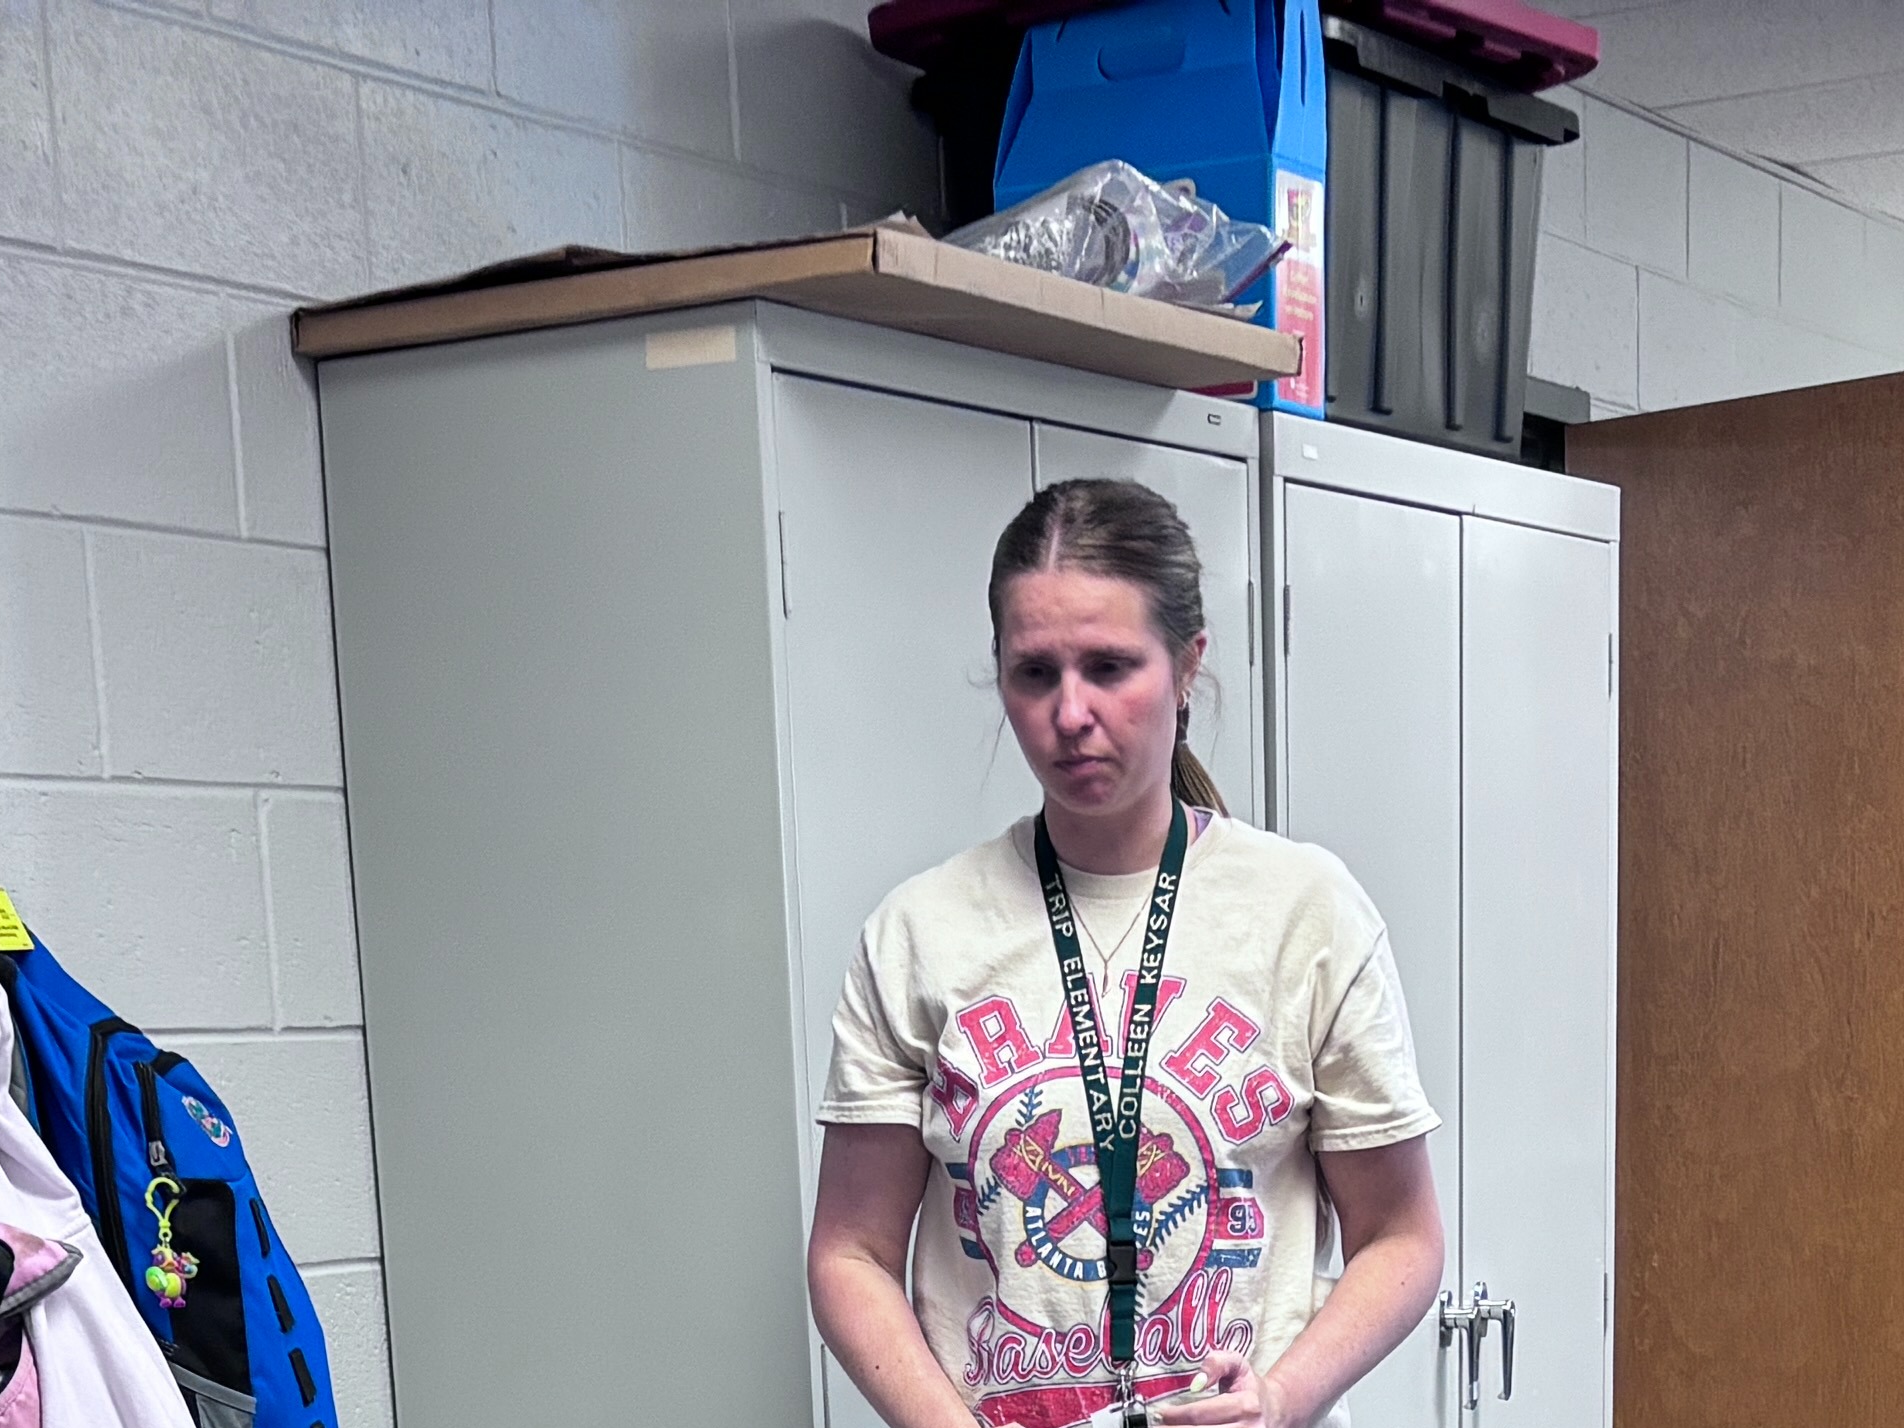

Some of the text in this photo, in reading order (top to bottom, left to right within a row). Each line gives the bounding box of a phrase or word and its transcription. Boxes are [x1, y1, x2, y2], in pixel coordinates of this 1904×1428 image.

[1045, 872, 1075, 938] TRIP
[1118, 871, 1178, 1139] COLLEEN KEYSAR
[1025, 1205, 1084, 1279] ATLANTA
[964, 1266, 1253, 1387] Baseall
